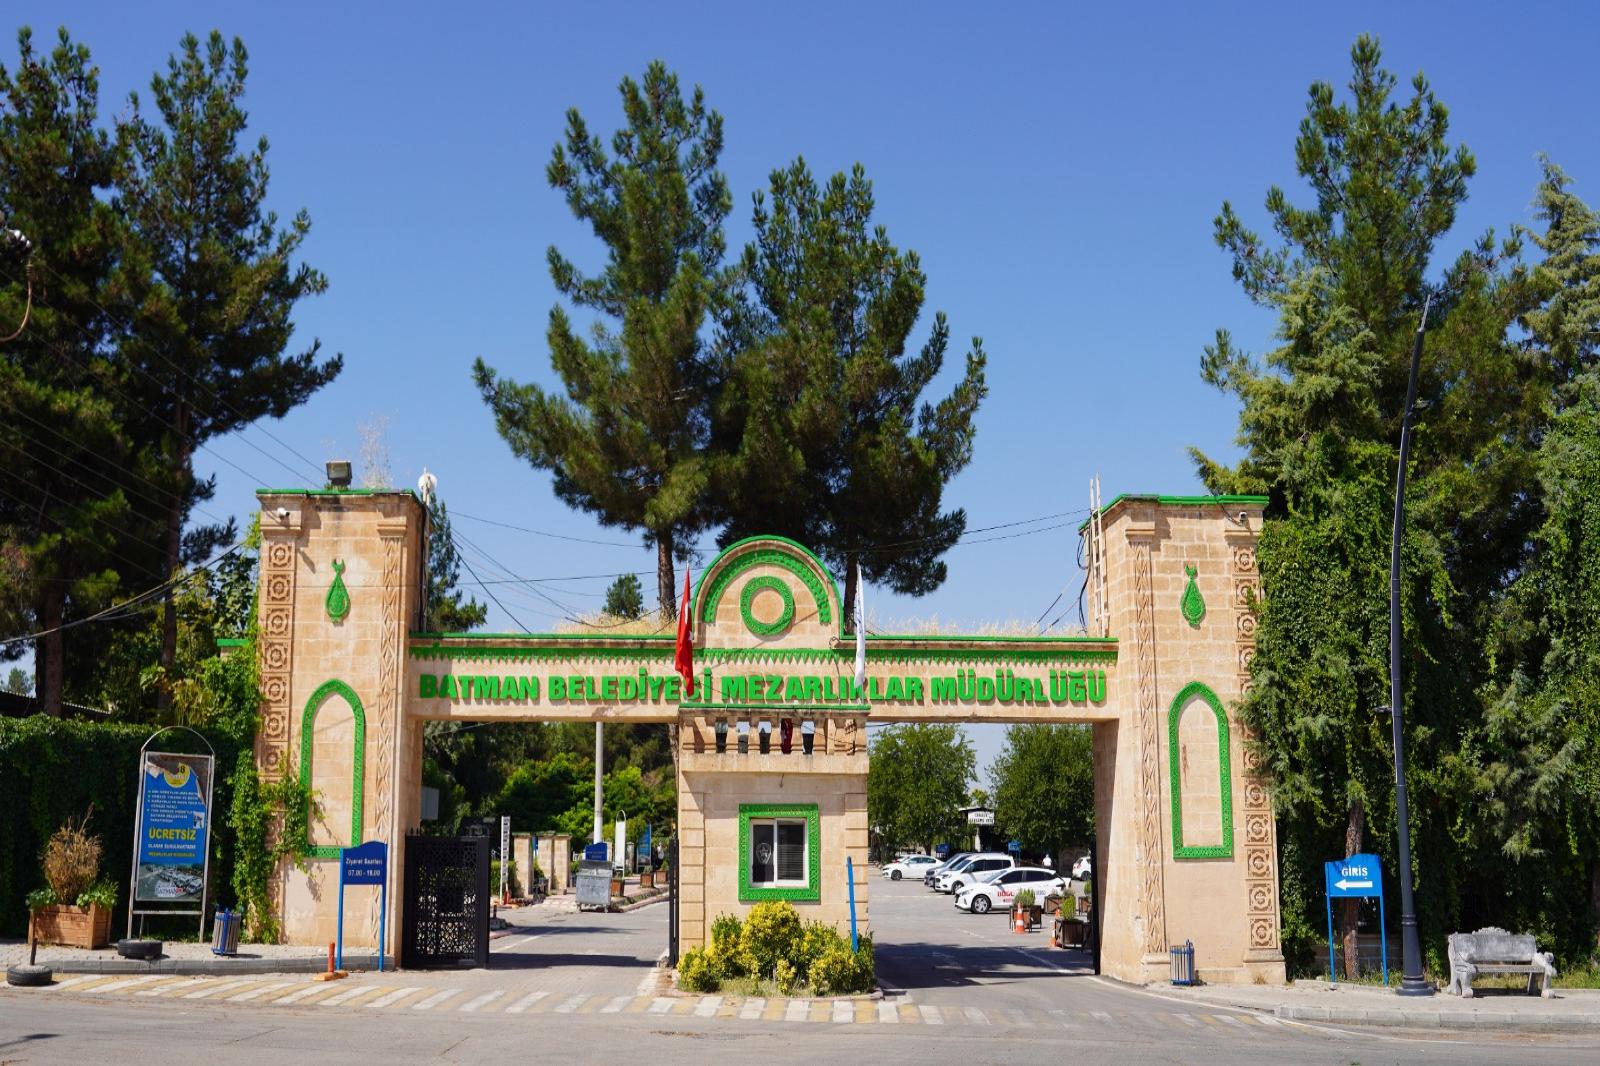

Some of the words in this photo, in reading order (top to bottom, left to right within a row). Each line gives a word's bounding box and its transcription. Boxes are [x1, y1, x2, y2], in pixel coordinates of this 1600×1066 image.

[419, 673, 539, 700] BATMAN
[721, 675, 924, 701] MEZARLIKLAR
[930, 668, 1106, 702] MÜDÜRLÜĞÜ
[149, 827, 196, 840] ÜCRETSİZ
[346, 858, 363, 866] Ziyaret
[1341, 865, 1368, 879] GİRİŞ
